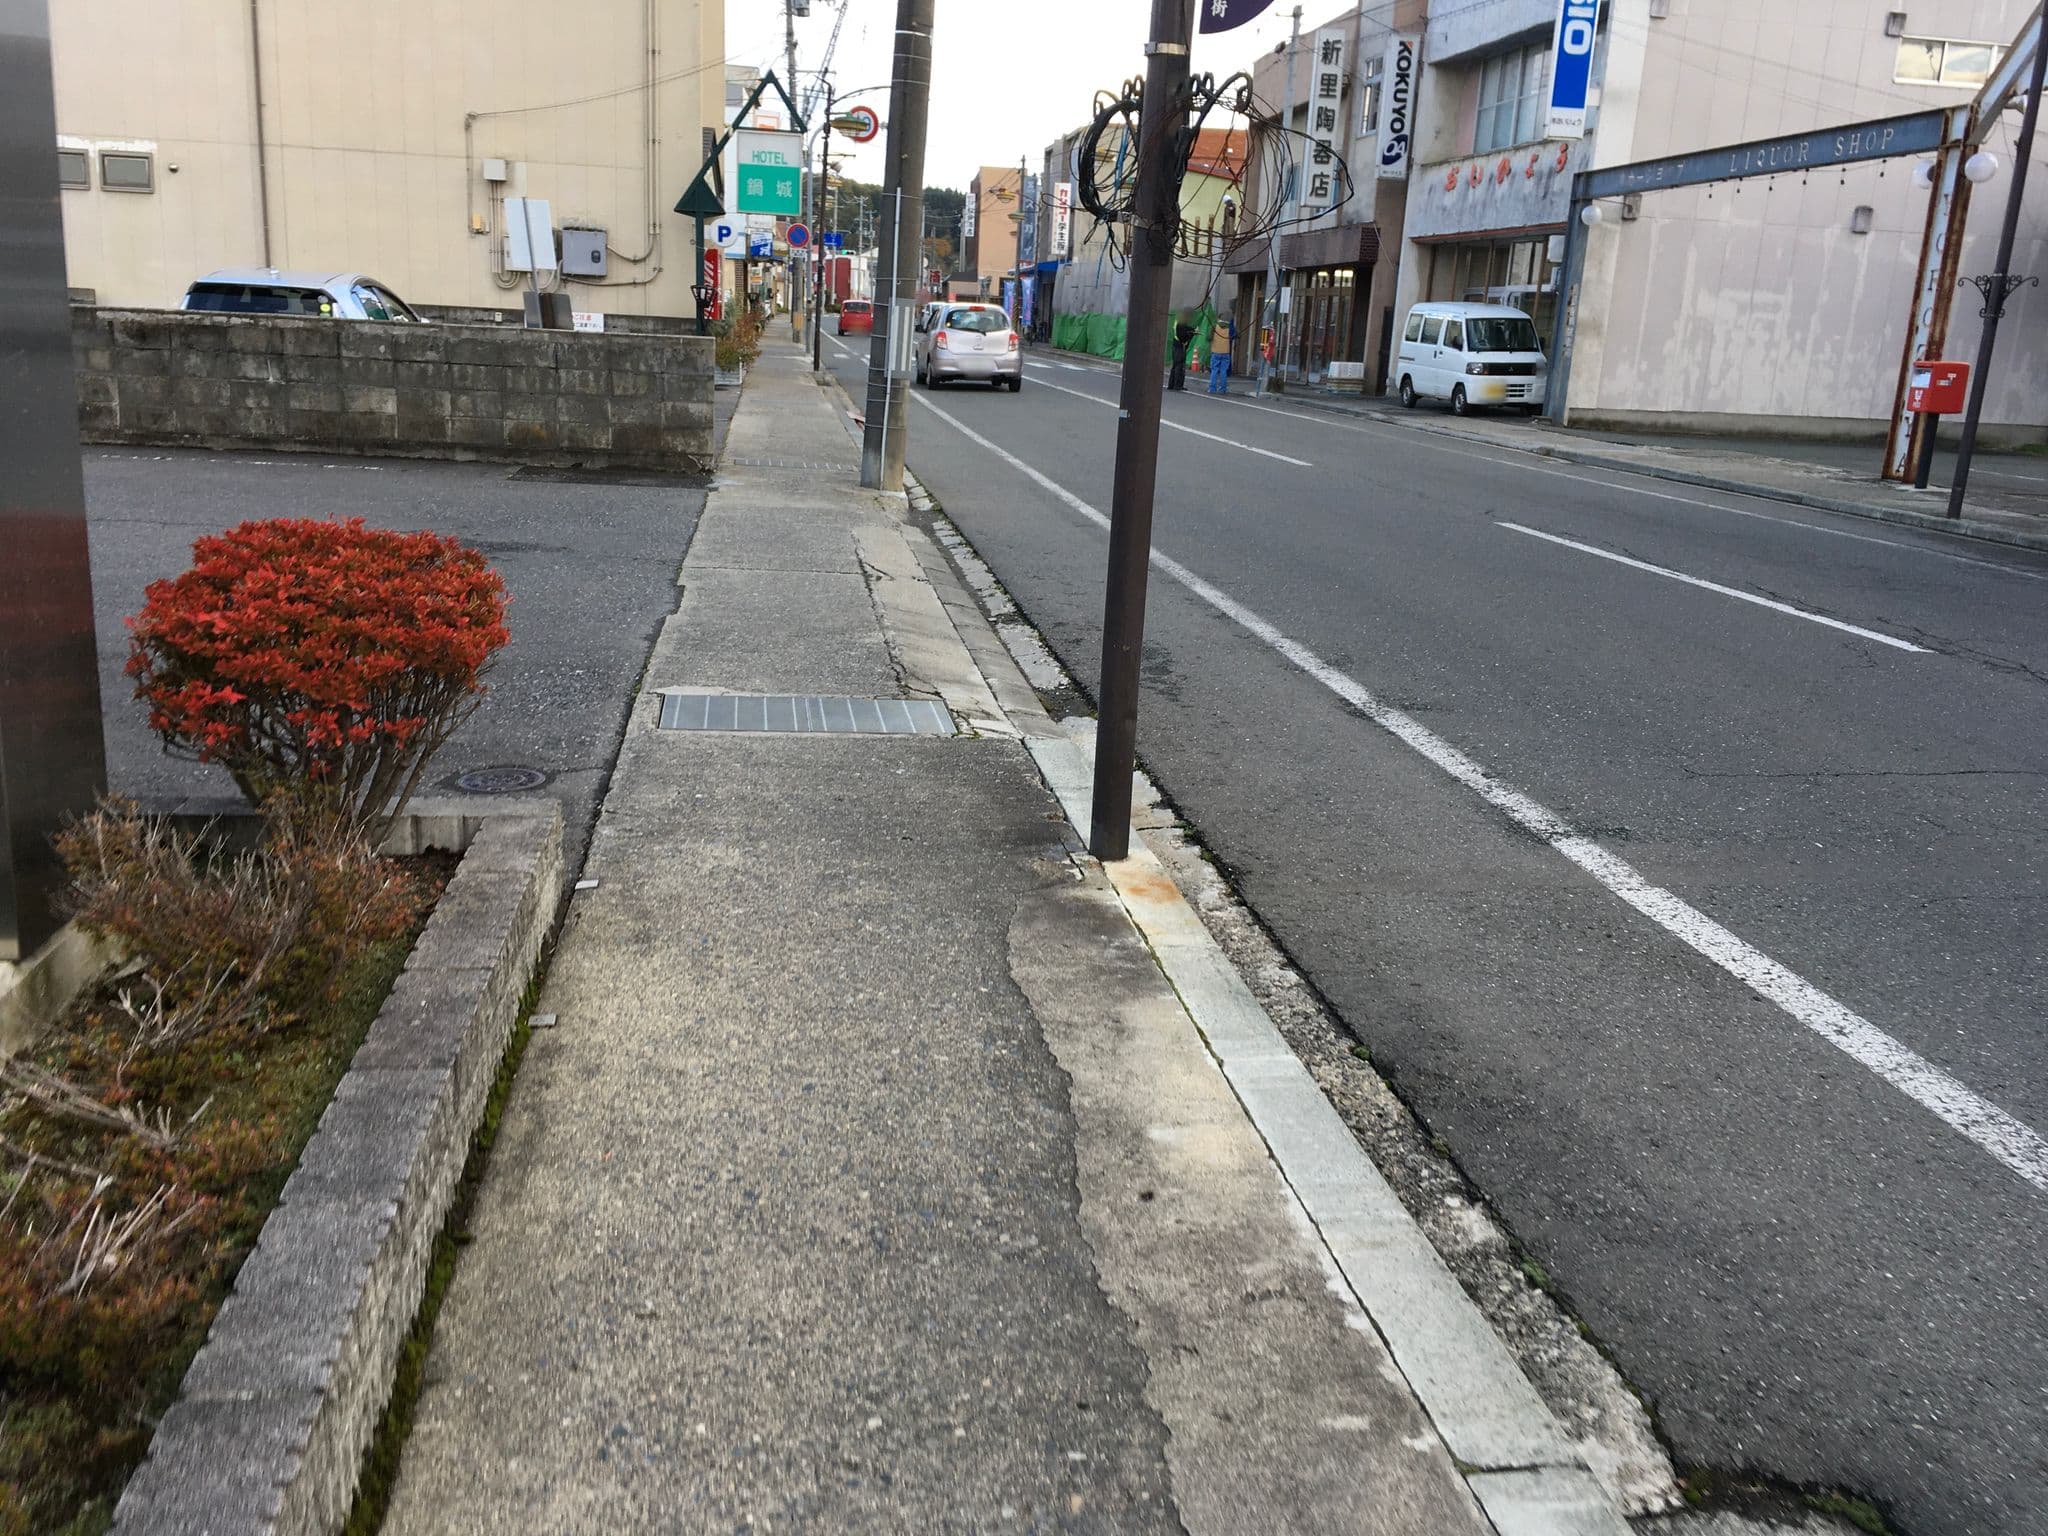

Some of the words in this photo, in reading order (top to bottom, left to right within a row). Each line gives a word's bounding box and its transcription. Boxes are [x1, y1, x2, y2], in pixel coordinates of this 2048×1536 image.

[1563, 0, 1597, 55] IO
[1390, 40, 1413, 134] KOKUYO
[1308, 38, 1342, 198] 新里陶器店
[752, 150, 788, 165] HOTEL
[1729, 141, 1810, 173] LIQUOR
[1834, 127, 1895, 158] SHOP
[717, 225, 731, 243] P
